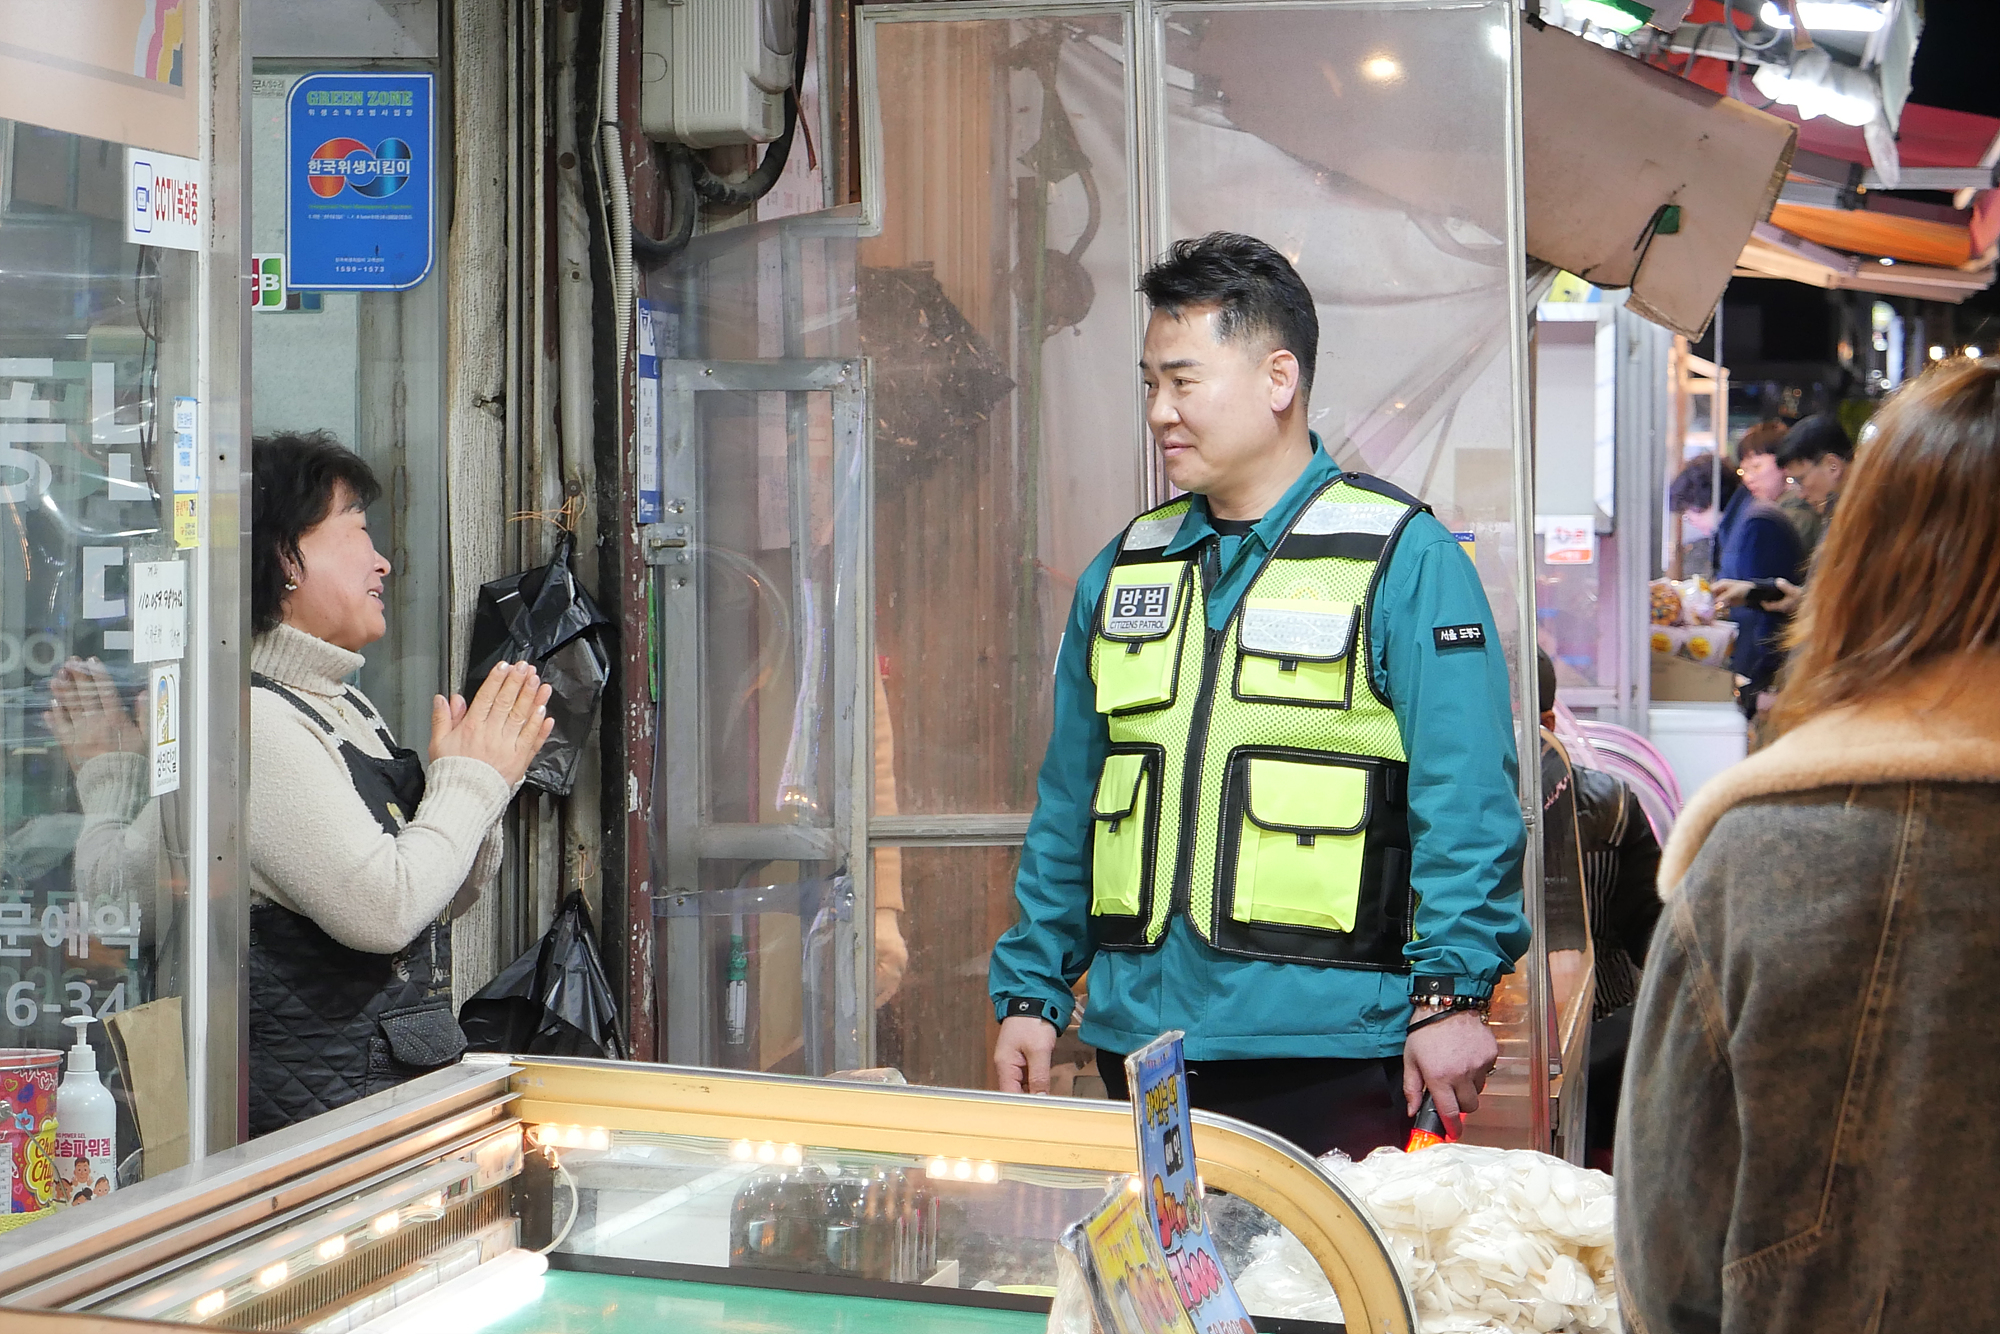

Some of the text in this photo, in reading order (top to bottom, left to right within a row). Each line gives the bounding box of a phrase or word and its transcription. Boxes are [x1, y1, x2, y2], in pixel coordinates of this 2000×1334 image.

[306, 90, 413, 106] GREEN ZONE
[307, 159, 411, 175] 한국위생지킴이
[154, 175, 198, 227] CCTV녹화중
[1119, 587, 1165, 617] 방범
[1109, 619, 1165, 630] CITIZENS PATROL
[1440, 627, 1481, 641] 서울 도봉구
